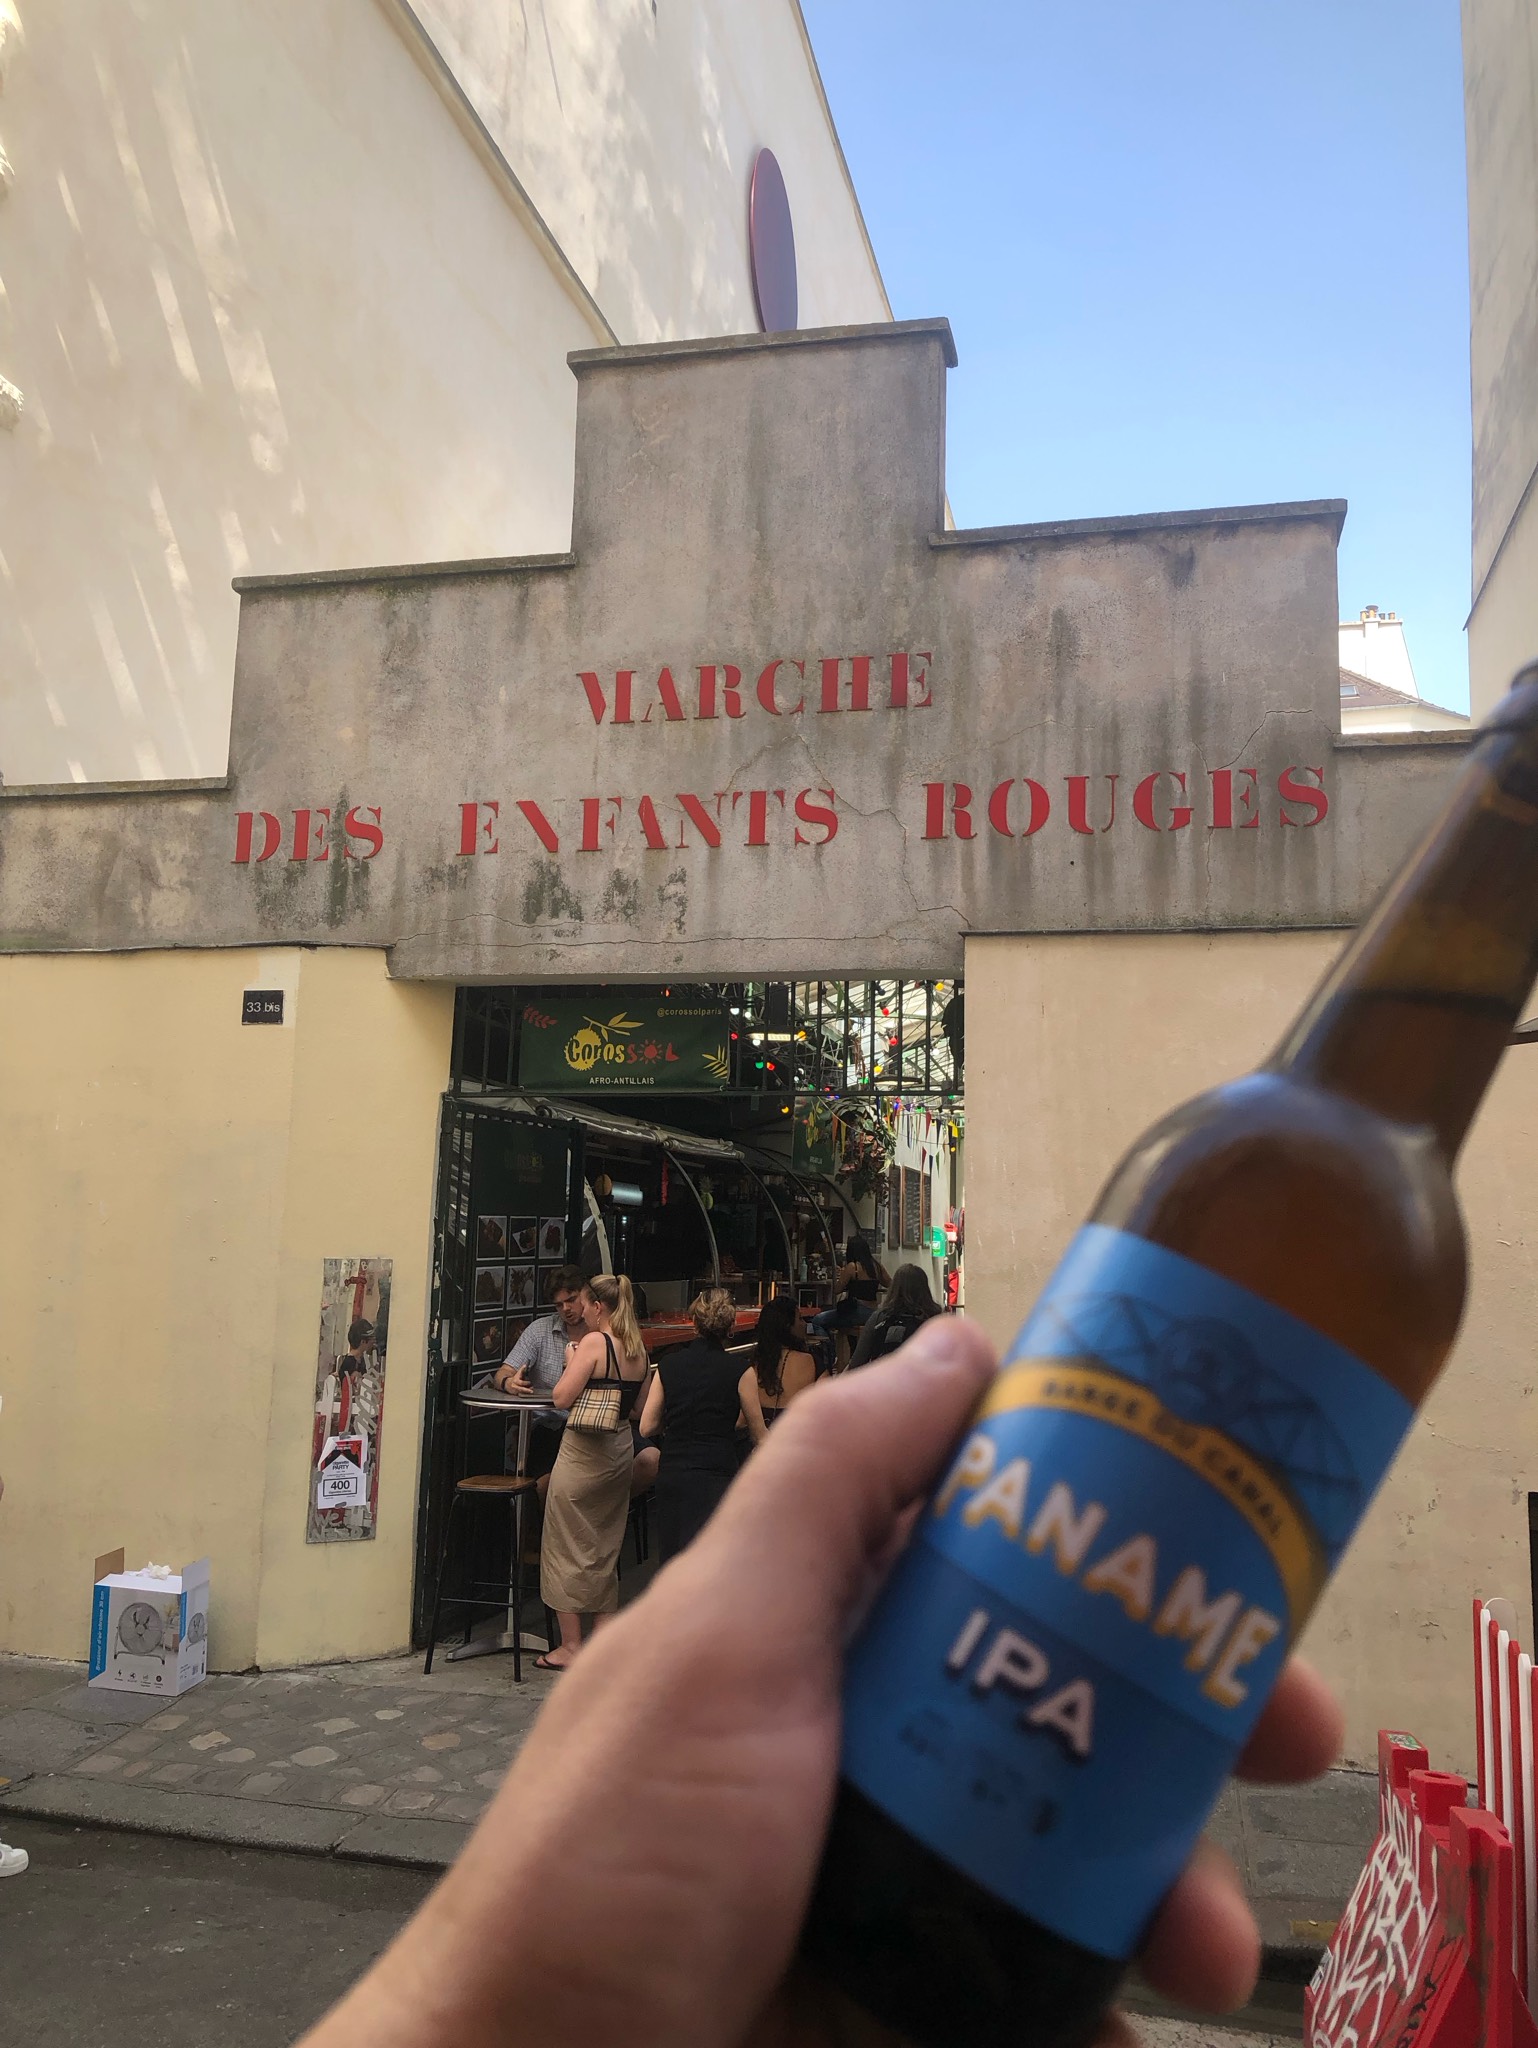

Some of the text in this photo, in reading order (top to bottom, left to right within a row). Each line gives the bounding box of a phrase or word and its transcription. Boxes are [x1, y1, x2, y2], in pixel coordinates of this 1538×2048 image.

[576, 651, 933, 725] MARCHE
[230, 765, 1329, 864] DES ENFANTS ROUGES
[246, 1001, 281, 1013] 33 bis
[656, 1007, 723, 1018] @corossolparis
[589, 1076, 655, 1086] AFRO-ANTILLAIS
[330, 1480, 351, 1491] 400
[933, 1432, 1284, 1709] PANAME
[944, 1605, 1098, 1759] IPA
